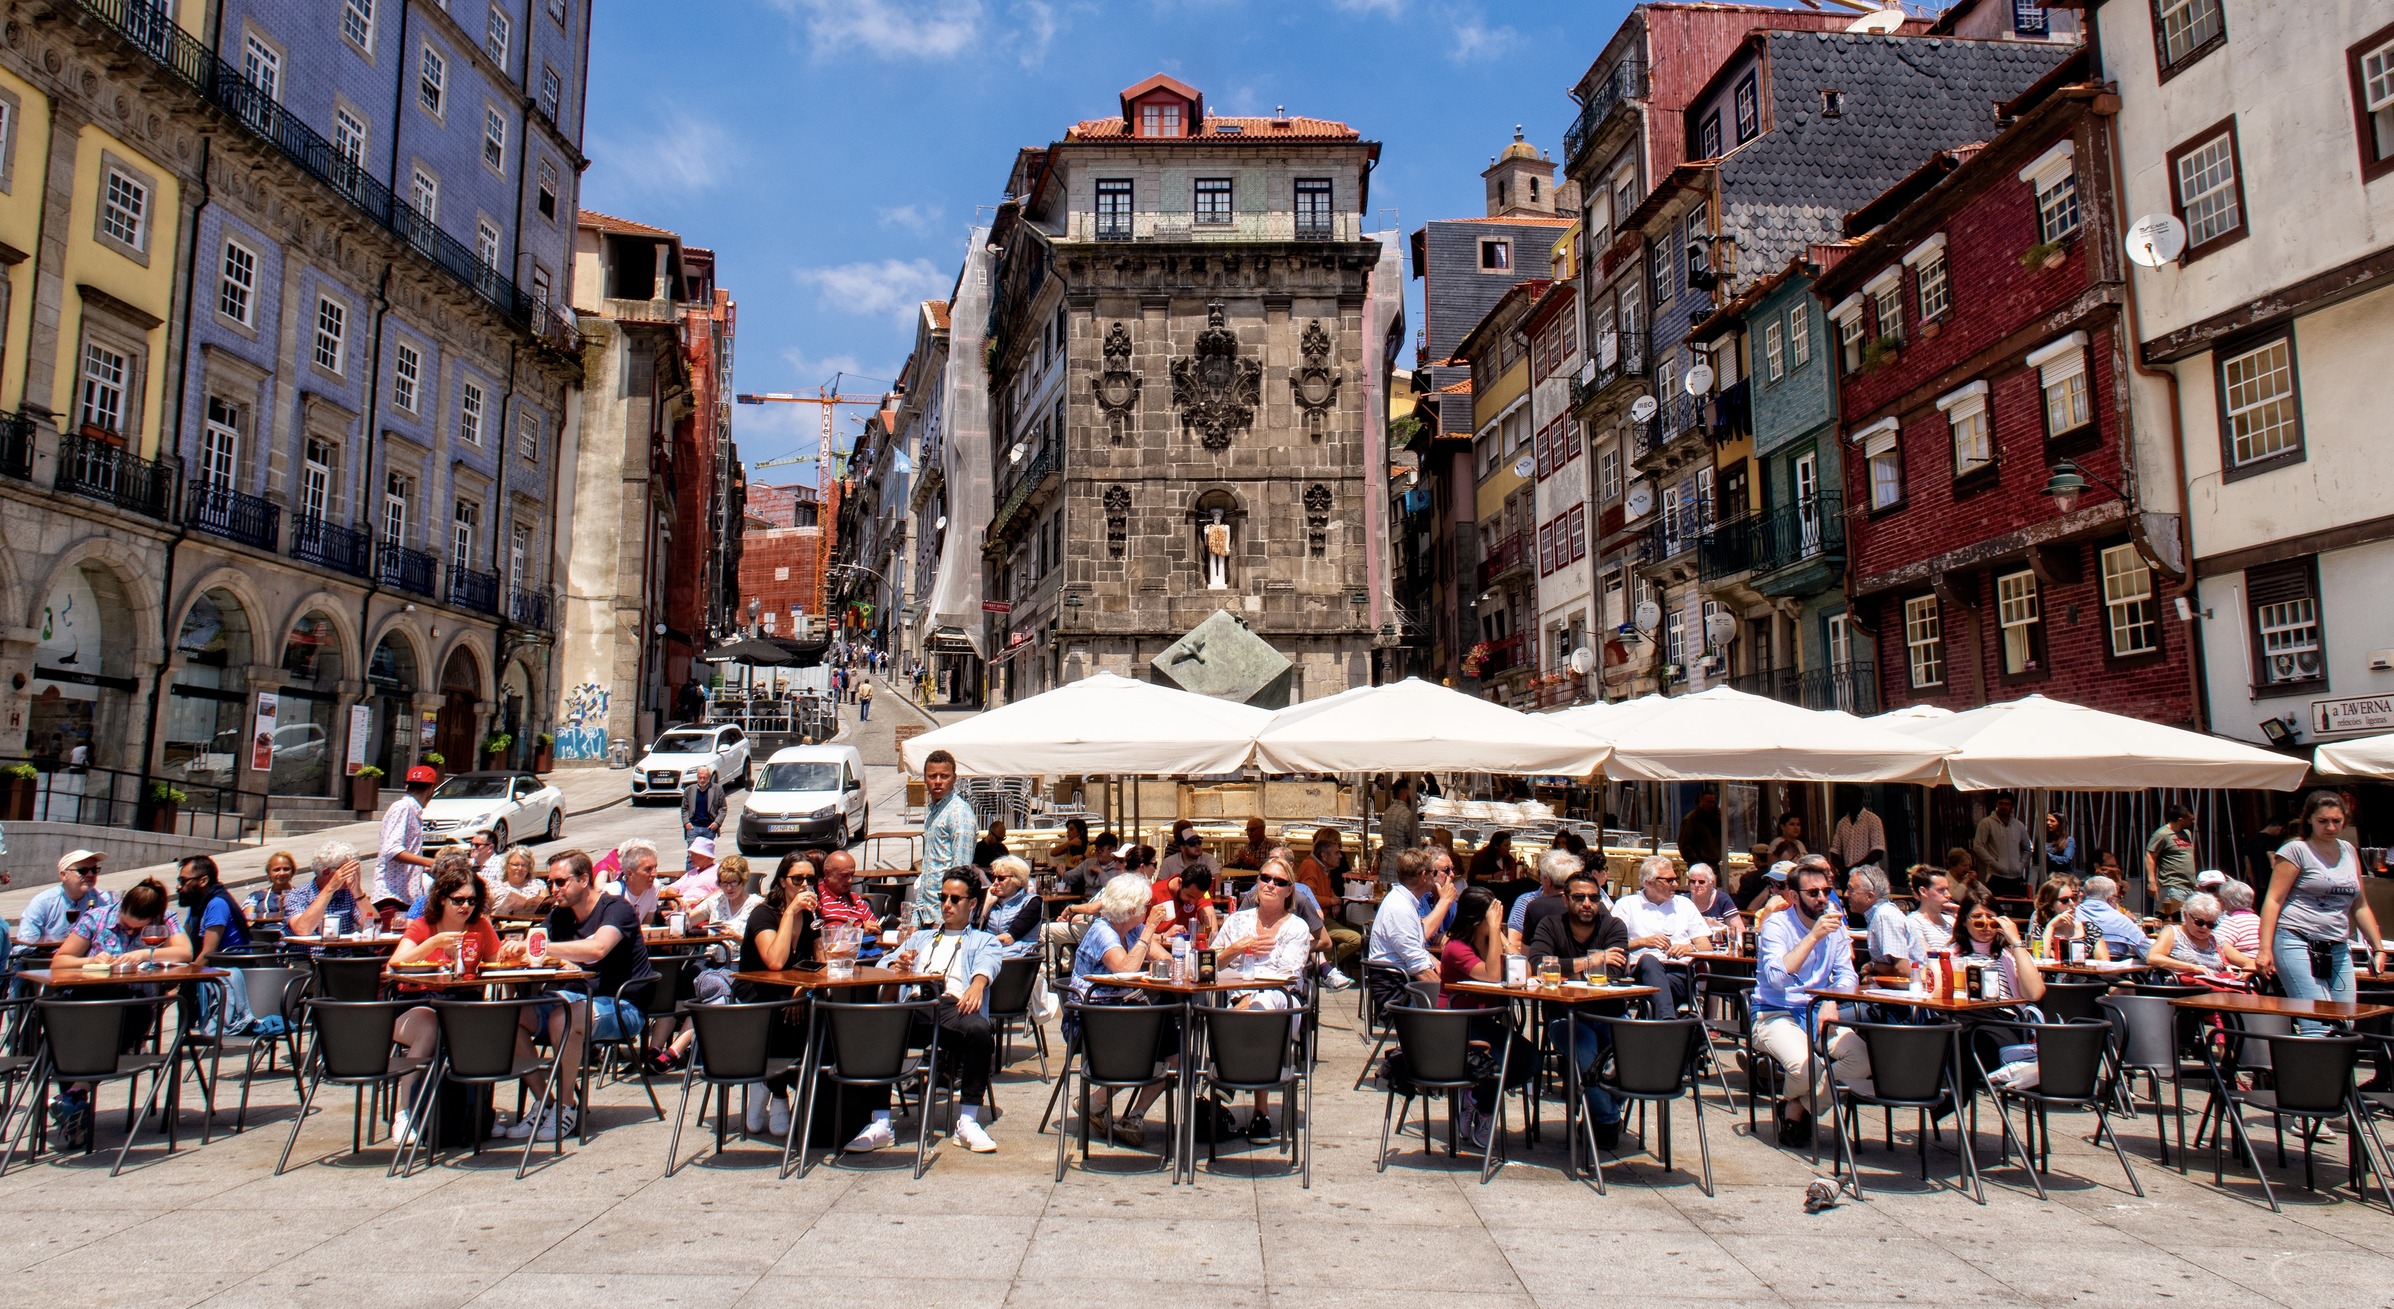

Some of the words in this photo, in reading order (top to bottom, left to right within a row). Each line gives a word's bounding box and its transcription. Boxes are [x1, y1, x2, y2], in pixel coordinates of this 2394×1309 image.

[1637, 401, 1653, 409] MEO
[1633, 495, 1648, 504] NOS
[2333, 707, 2339, 717] a
[2340, 700, 2392, 716] TAVERNA
[11, 712, 20, 726] H
